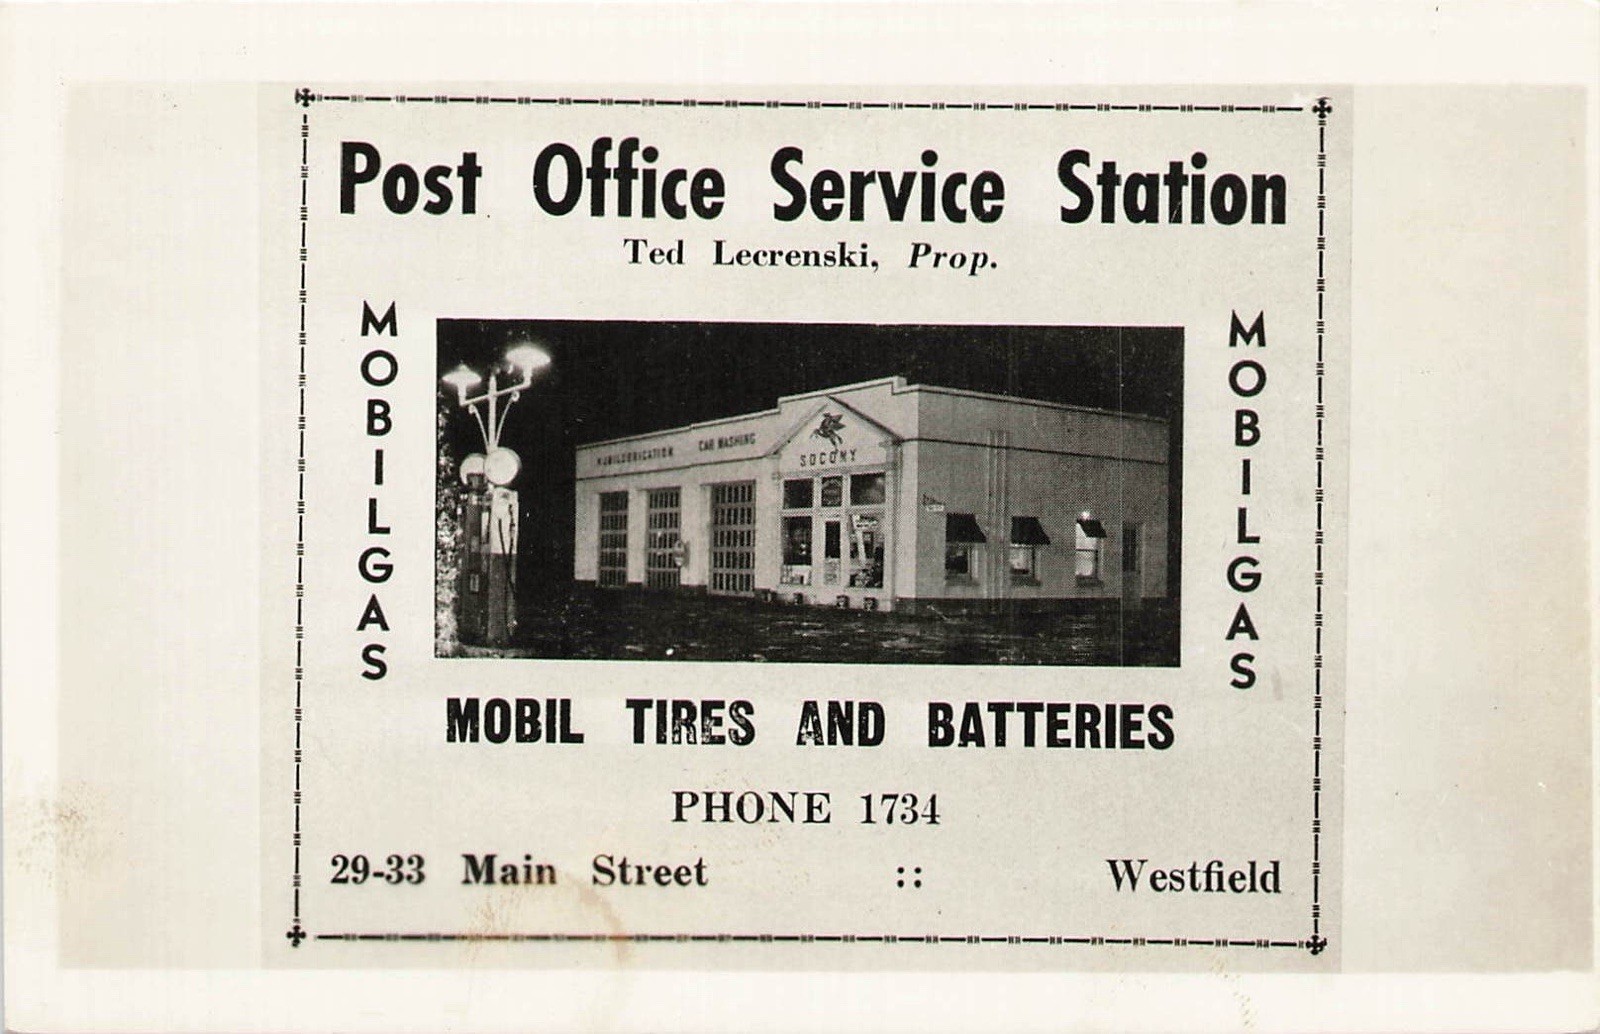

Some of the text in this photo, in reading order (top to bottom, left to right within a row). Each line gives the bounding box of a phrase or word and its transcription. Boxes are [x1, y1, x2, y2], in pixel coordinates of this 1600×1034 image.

[340, 136, 1287, 226] Post Office Service Station
[623, 238, 998, 277] Ted Lecrenski, Prop.
[800, 449, 857, 468] SOCONY
[356, 300, 399, 681] MOBILGAS
[1225, 309, 1267, 690] MOBILGAS
[446, 697, 1175, 751] MOBIL TIRES AND BATTERIES
[672, 791, 941, 825] PHONE 1734
[330, 854, 427, 885] 29-33
[461, 853, 558, 886] Main
[592, 854, 708, 887] Street
[1105, 859, 1282, 894] Westfield
